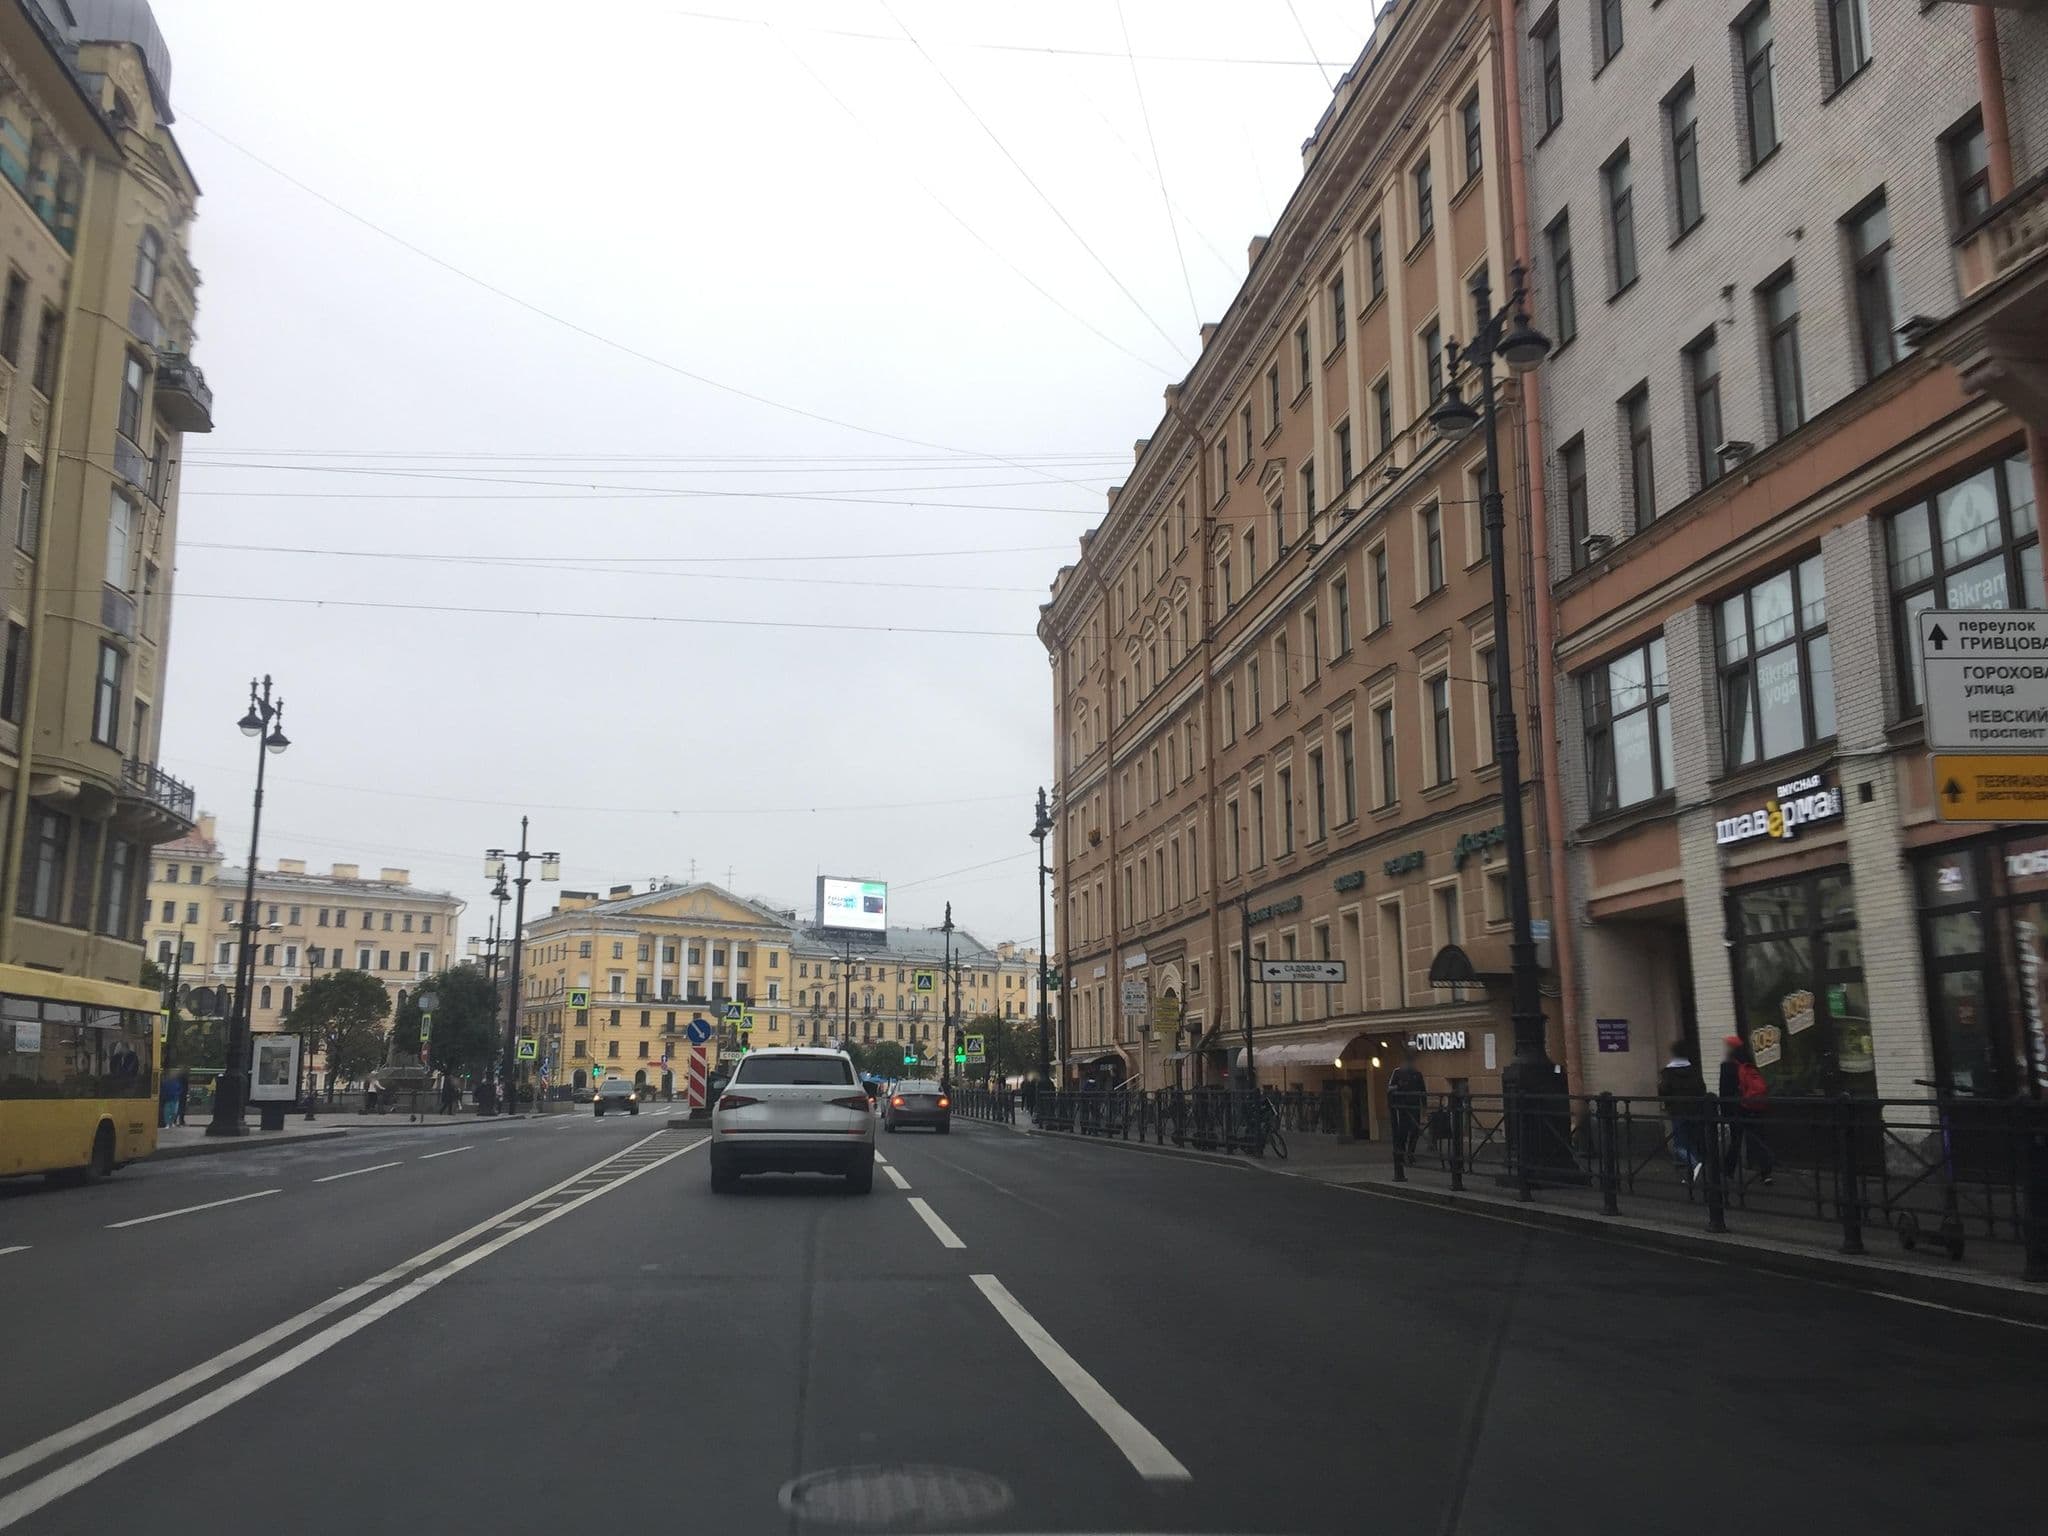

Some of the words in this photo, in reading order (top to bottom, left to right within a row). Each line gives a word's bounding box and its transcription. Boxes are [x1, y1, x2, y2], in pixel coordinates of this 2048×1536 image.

[1959, 621, 2036, 634] переулок
[1964, 684, 2014, 698] улица
[1968, 707, 2048, 724] НЕВСКИЙ
[1969, 727, 2046, 741] проспект
[1284, 964, 1323, 973] САДОВАЯ
[1417, 1031, 1465, 1052] СТОЛОВАЯ
